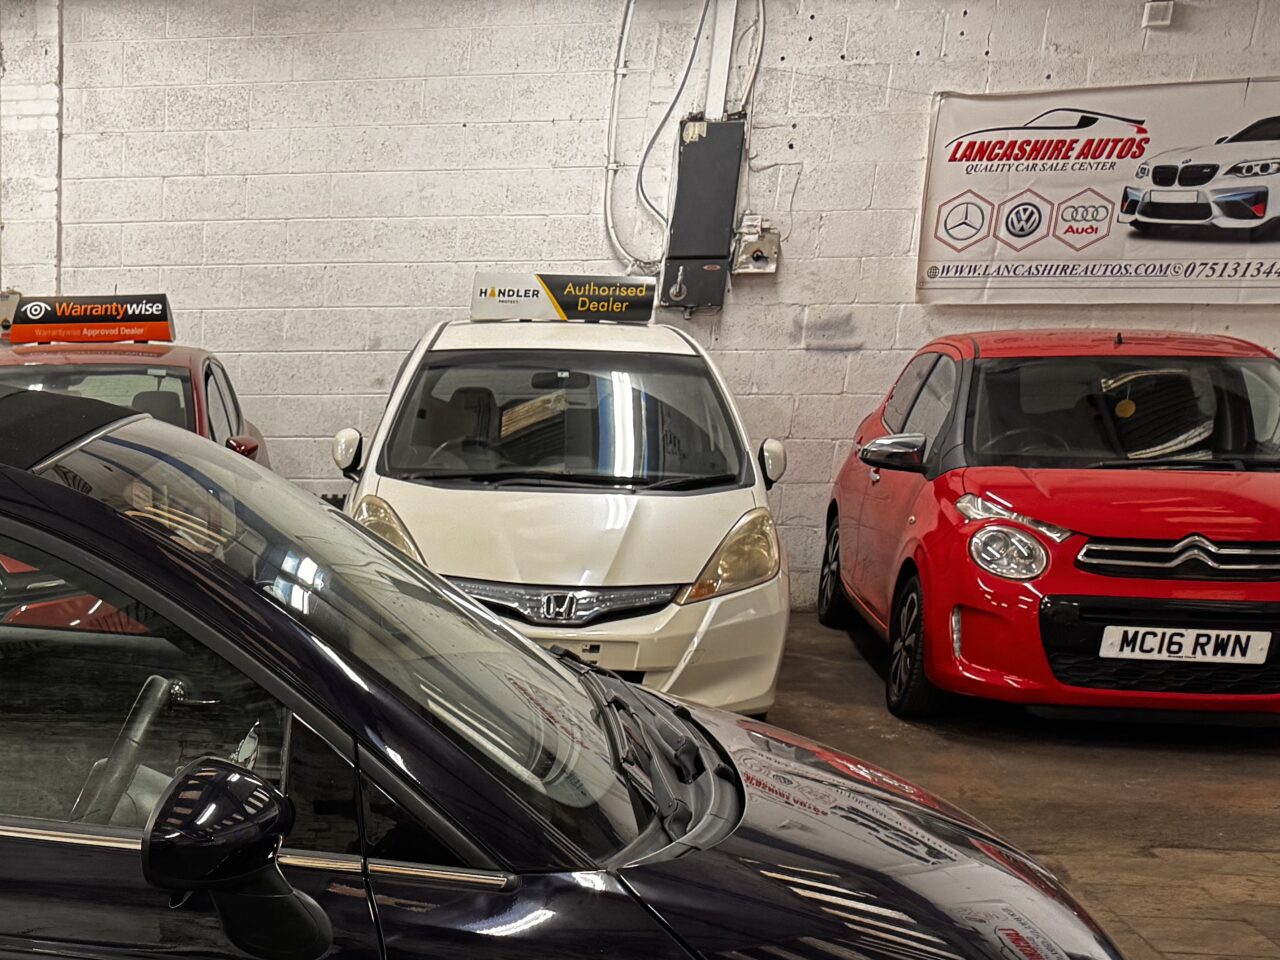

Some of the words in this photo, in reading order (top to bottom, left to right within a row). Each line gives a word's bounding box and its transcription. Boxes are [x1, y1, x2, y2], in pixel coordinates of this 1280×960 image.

[948, 139, 1080, 162] LANCASHIRE
[1075, 137, 1150, 160] AUTOS
[965, 163, 1014, 175] QUALITY
[1014, 163, 1039, 173] CAR
[1039, 162, 1068, 172] SALE
[1070, 161, 1117, 172] CENTER
[1063, 224, 1099, 236] Audi
[939, 262, 1171, 277] WWW.LANCASHIREAUTOS.COM
[564, 281, 647, 297] Authorised
[55, 299, 162, 319] Warrantywise
[577, 297, 629, 312] Dealer
[1118, 630, 1186, 655] MC16
[1191, 633, 1252, 658] RWN
